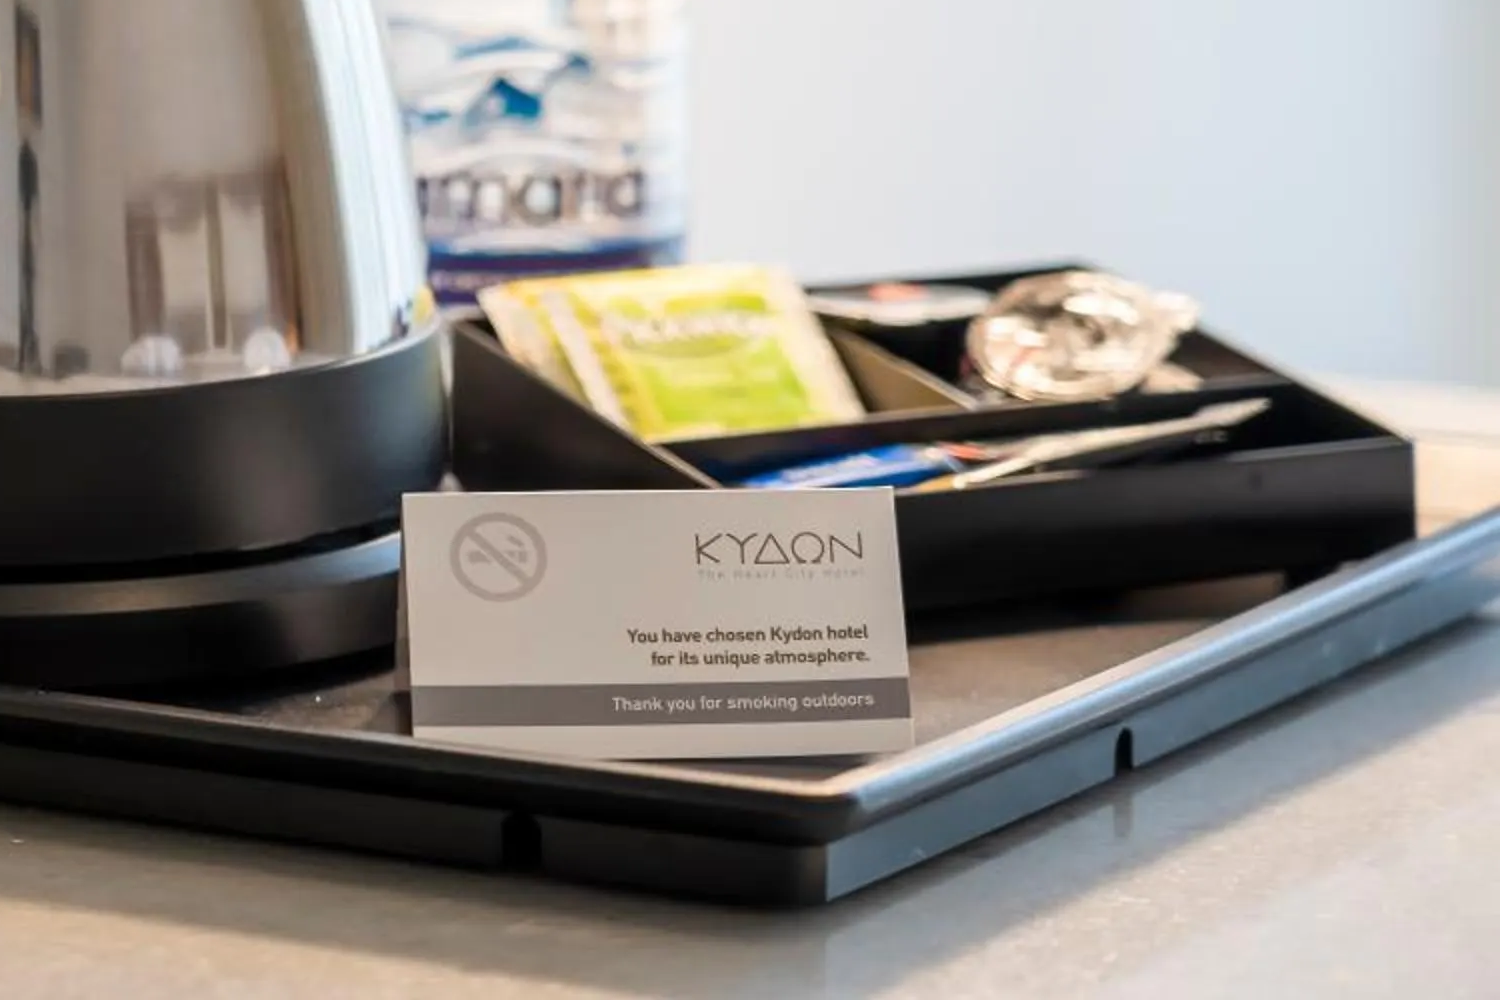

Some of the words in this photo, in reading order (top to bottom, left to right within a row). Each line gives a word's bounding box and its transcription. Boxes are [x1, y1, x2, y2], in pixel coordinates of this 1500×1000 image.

[627, 628, 659, 643] You
[662, 628, 702, 643] have
[706, 626, 766, 642] chosen
[770, 625, 823, 644] Kydon
[826, 623, 869, 640] hotel
[651, 651, 675, 665] for
[679, 650, 700, 665] its
[703, 649, 760, 669] unique
[764, 648, 870, 667] atmosphere.
[612, 696, 662, 711] Thank
[667, 699, 696, 714] you
[700, 695, 723, 709] for
[727, 695, 798, 712] smoking
[802, 692, 875, 708] outdoors
